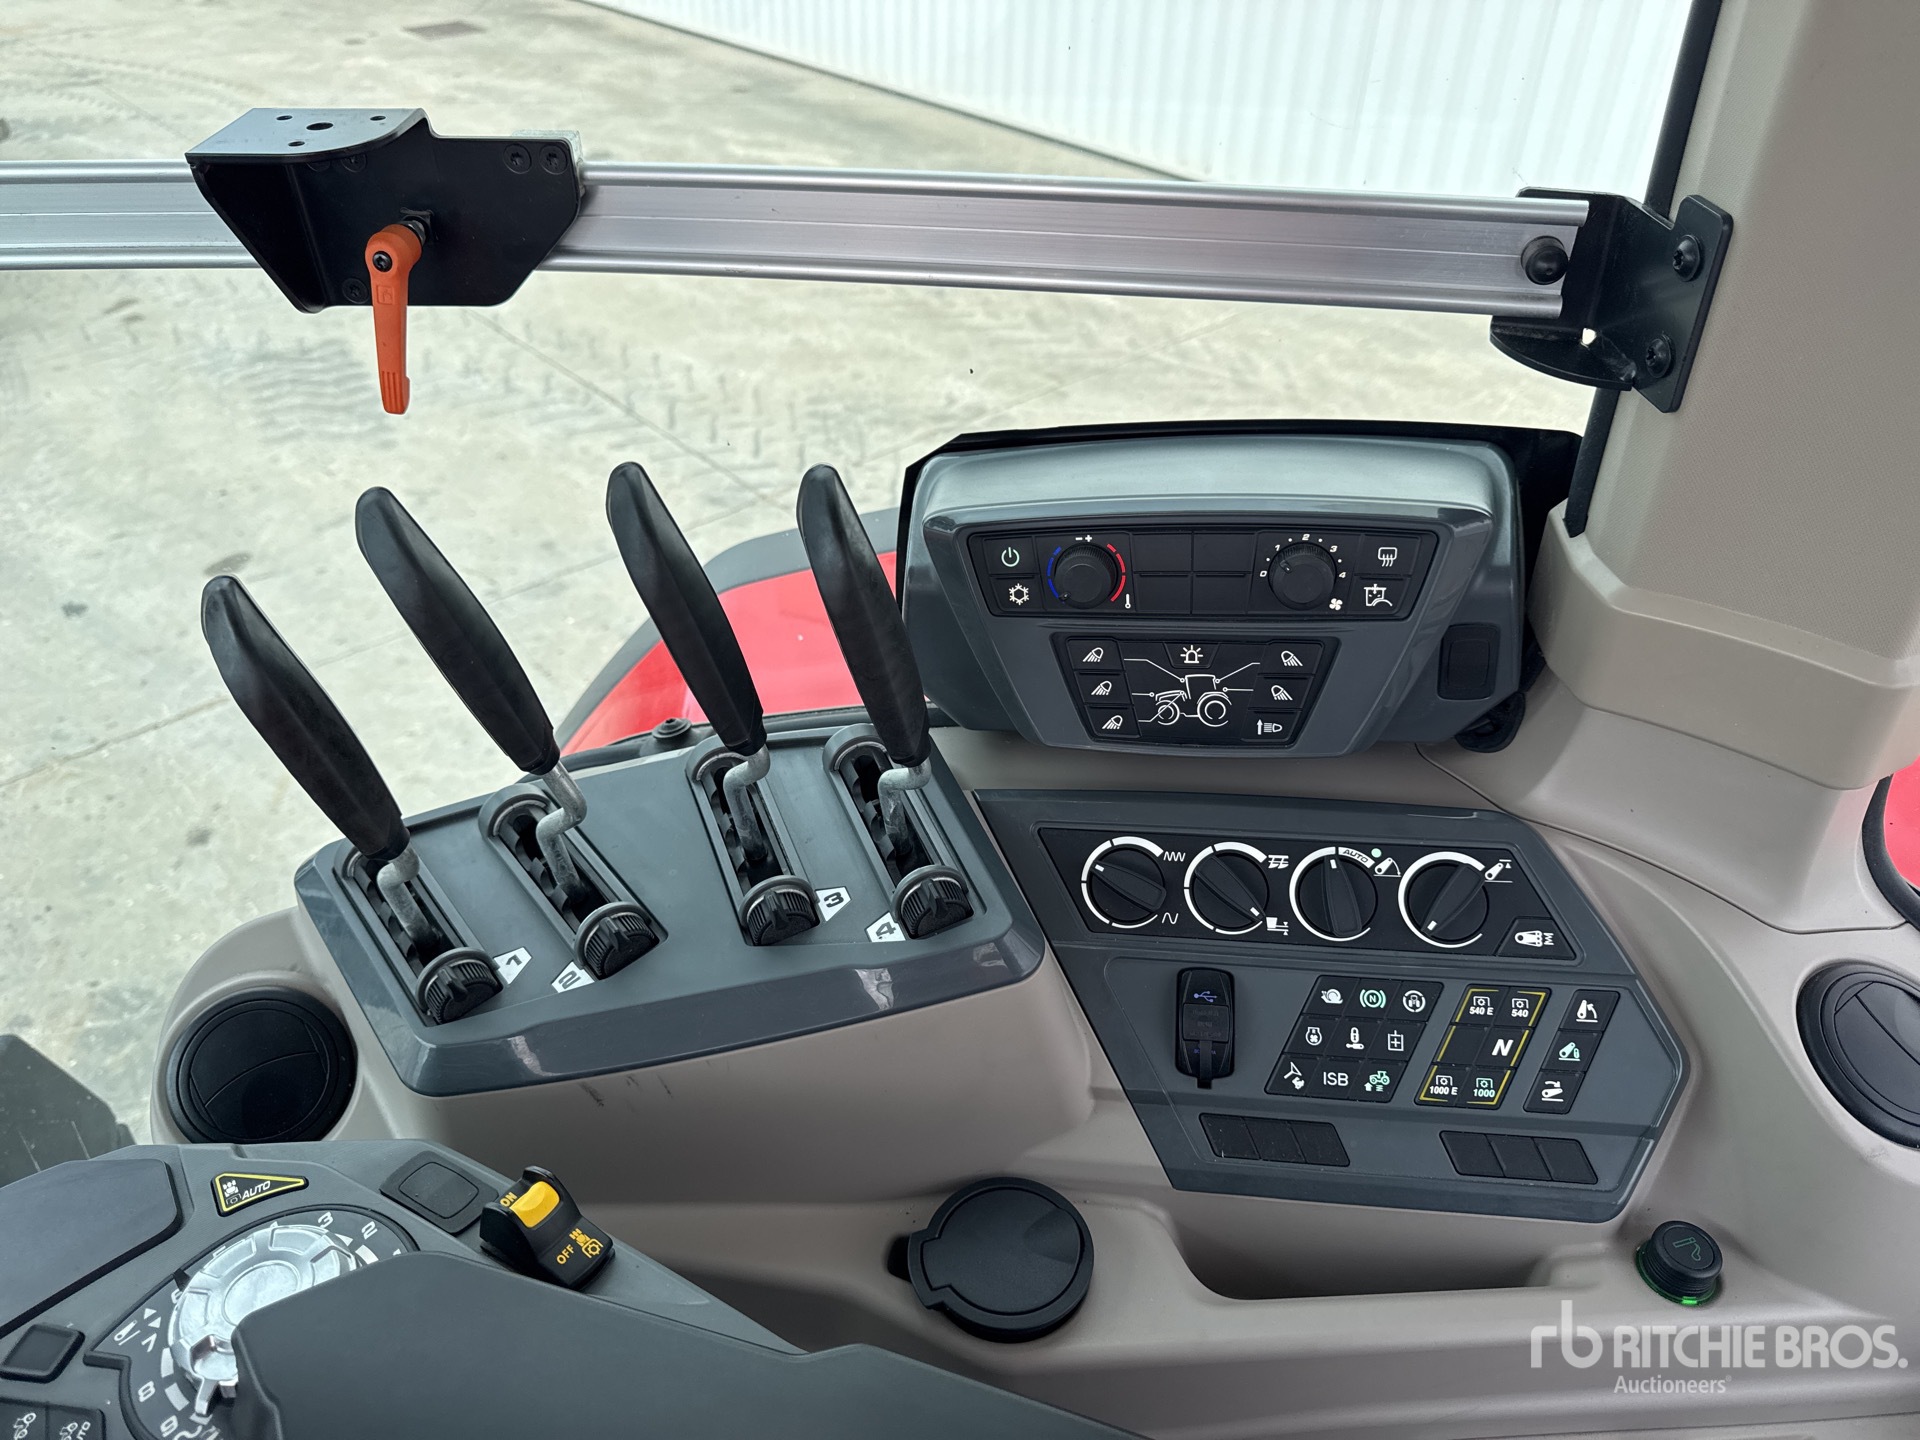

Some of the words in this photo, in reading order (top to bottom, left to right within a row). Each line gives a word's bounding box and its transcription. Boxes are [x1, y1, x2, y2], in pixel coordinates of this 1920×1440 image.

[1302, 533, 1310, 541] 2
[1342, 849, 1369, 863] AUTO
[823, 891, 845, 908] 3
[875, 921, 897, 937] 4
[505, 954, 523, 966] 1
[558, 970, 582, 990] 2
[1369, 994, 1376, 1003] N
[1469, 1006, 1485, 1016] 540
[1486, 1007, 1494, 1016] E
[1511, 1008, 1529, 1018] 540
[1491, 1038, 1514, 1056] N
[1323, 1071, 1349, 1087] ISB
[1429, 1085, 1449, 1095] 1000
[1450, 1086, 1458, 1095] E
[1473, 1088, 1495, 1098] 1000
[241, 1180, 271, 1200] AUTO
[500, 1192, 518, 1207] ON
[317, 1211, 334, 1229] 3
[361, 1221, 378, 1240] 2
[556, 1244, 574, 1264] OFF
[137, 1380, 156, 1403] 8
